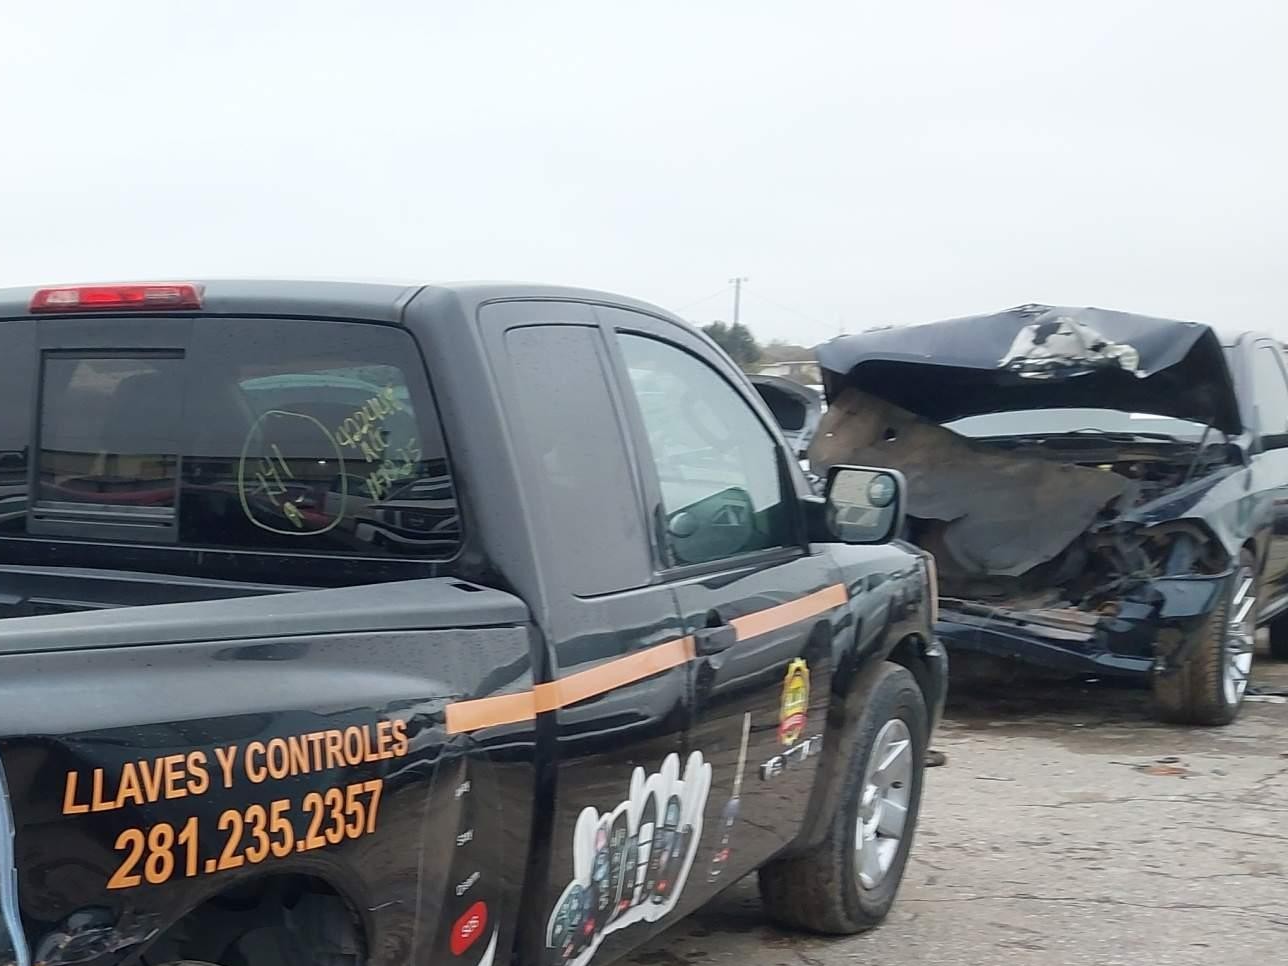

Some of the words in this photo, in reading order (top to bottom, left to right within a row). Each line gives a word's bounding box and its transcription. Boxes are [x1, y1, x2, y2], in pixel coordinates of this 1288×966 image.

[63, 751, 210, 814] LLAVES
[215, 746, 237, 788] Y
[244, 719, 408, 783] CONTROLES
[106, 779, 383, 889] 281.235.2357
